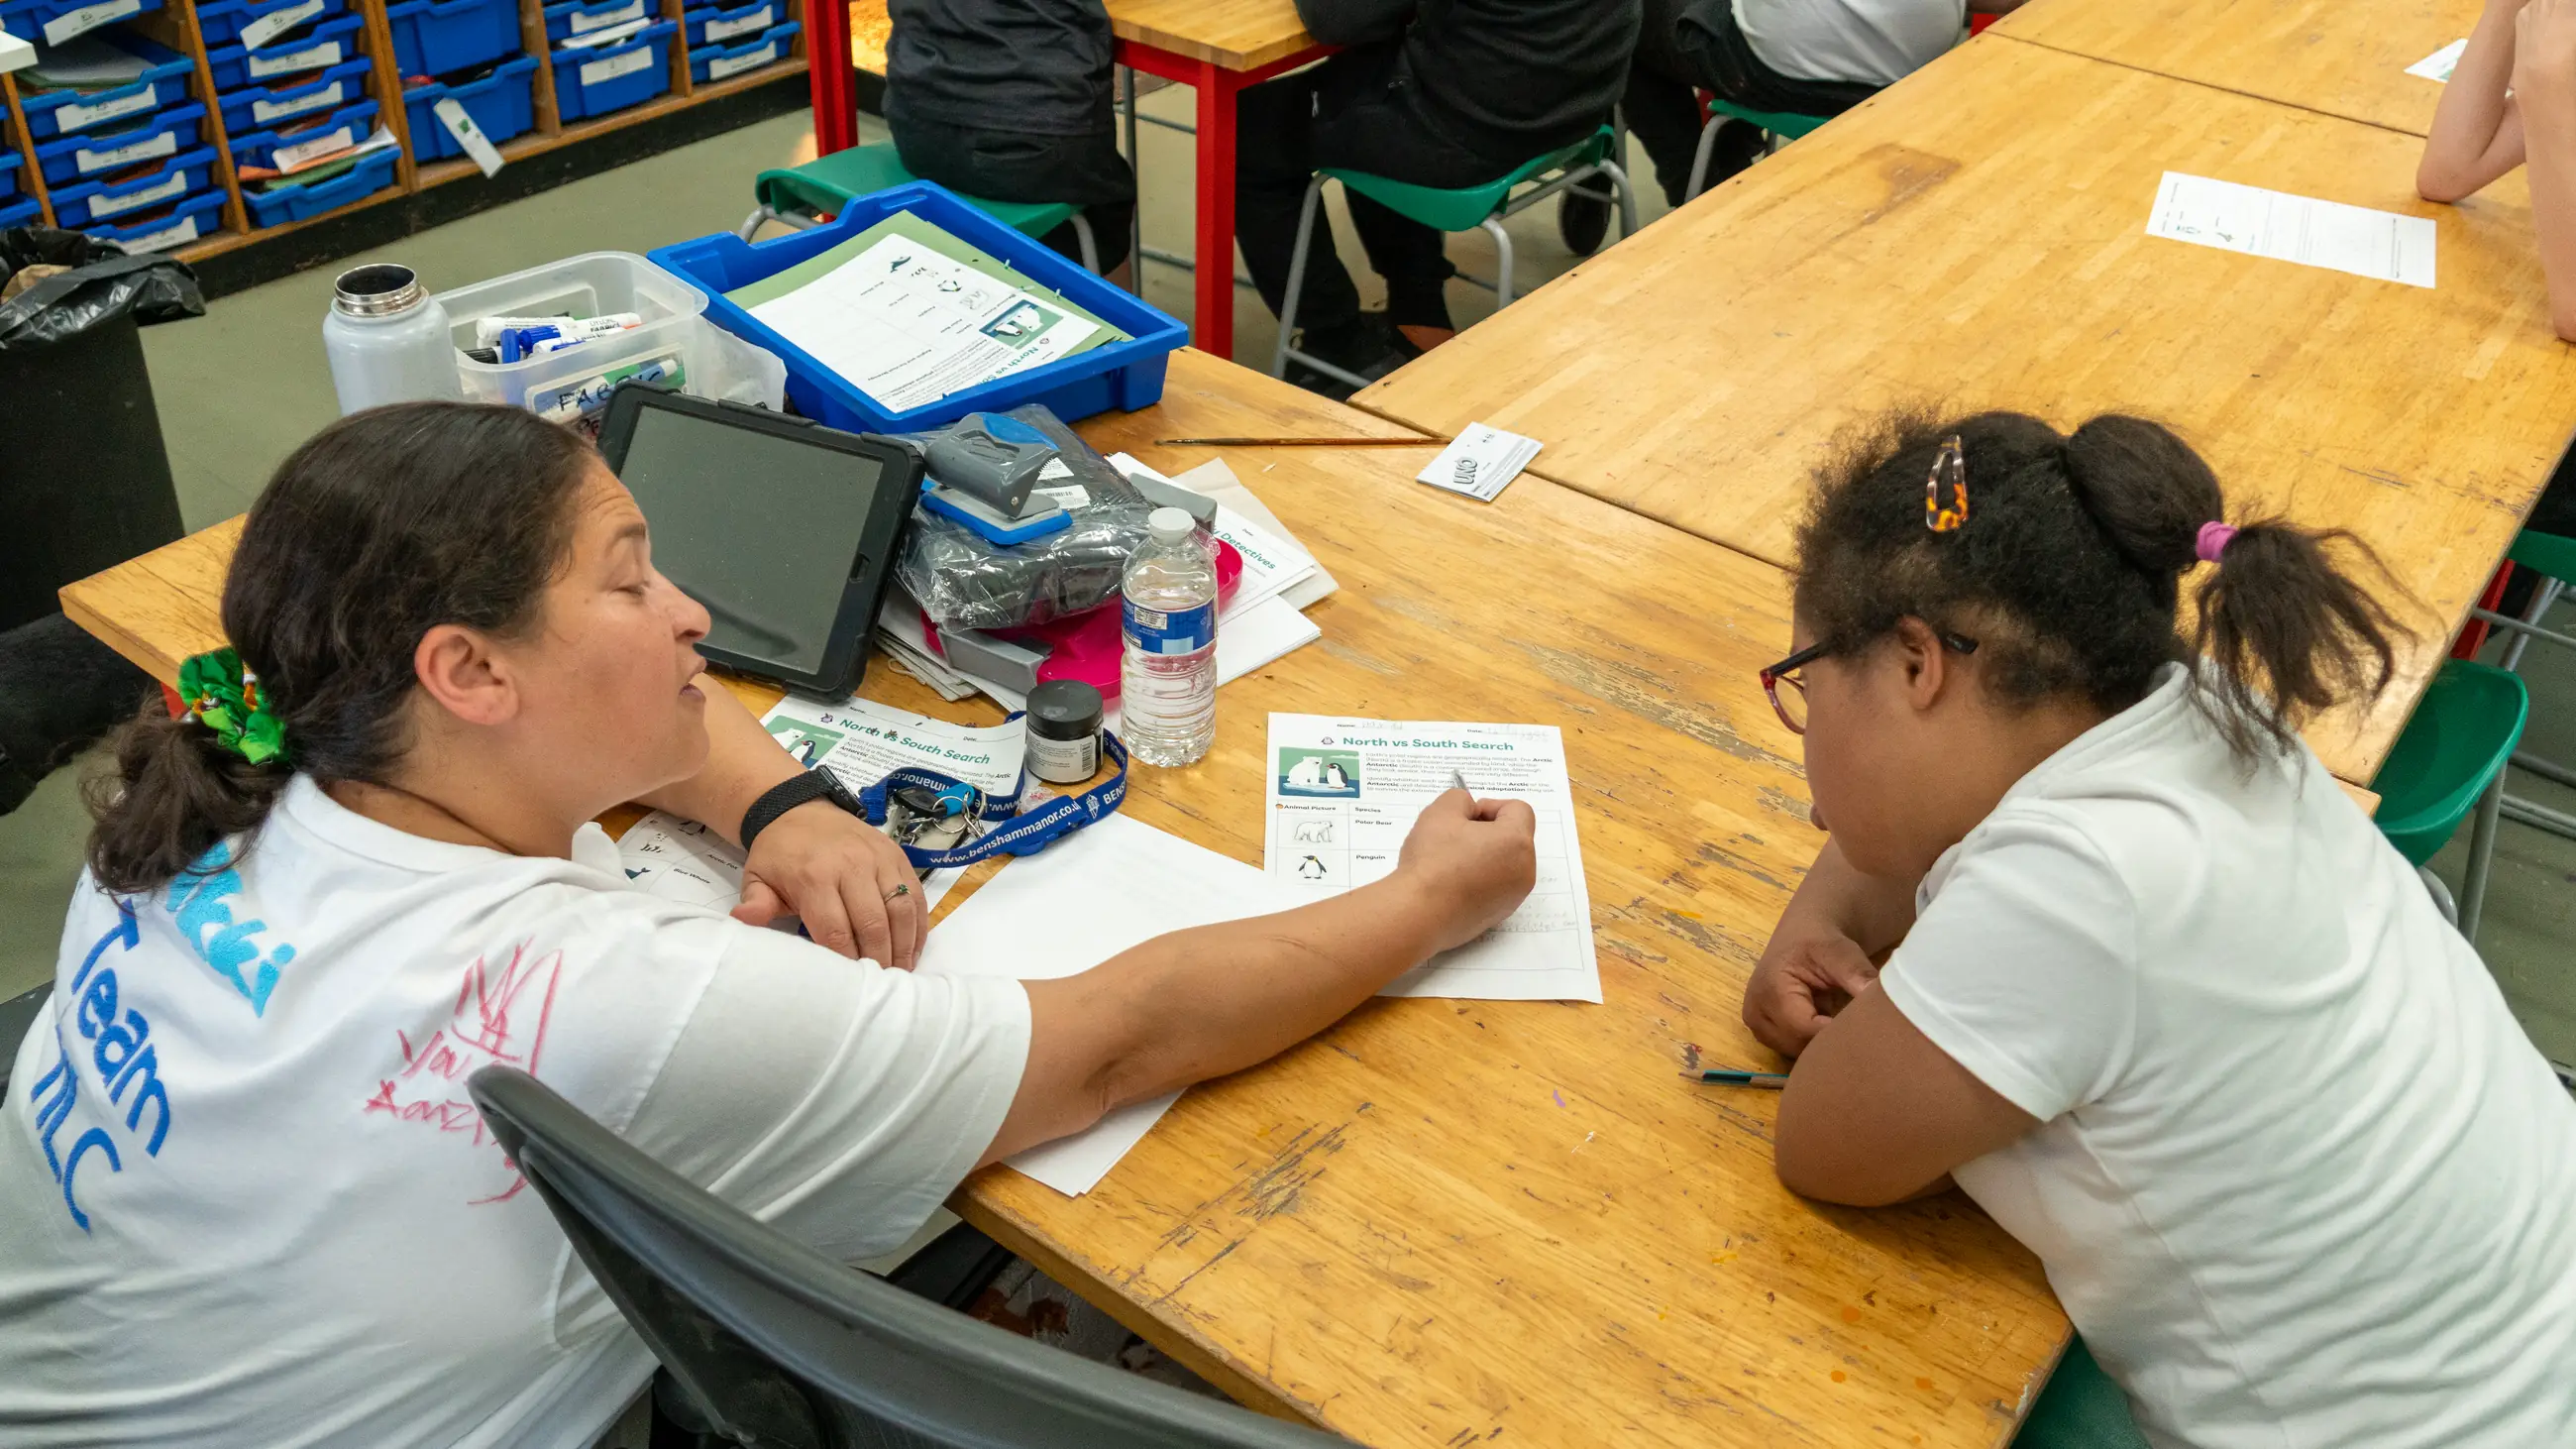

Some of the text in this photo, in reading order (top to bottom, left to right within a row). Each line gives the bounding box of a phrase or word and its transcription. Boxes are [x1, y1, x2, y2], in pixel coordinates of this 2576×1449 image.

[1008, 347, 1038, 367] North
[1452, 456, 1478, 484] UNO
[1221, 532, 1276, 569] Detectives
[839, 719, 880, 736] North
[900, 737, 941, 755] South
[943, 749, 991, 764] Search
[1342, 736, 1388, 747] North
[1412, 738, 1457, 749] South
[1461, 739, 1514, 751] Search
[707, 853, 726, 864] Arctic
[690, 872, 710, 884] Whale
[71, 898, 170, 1159] Team
